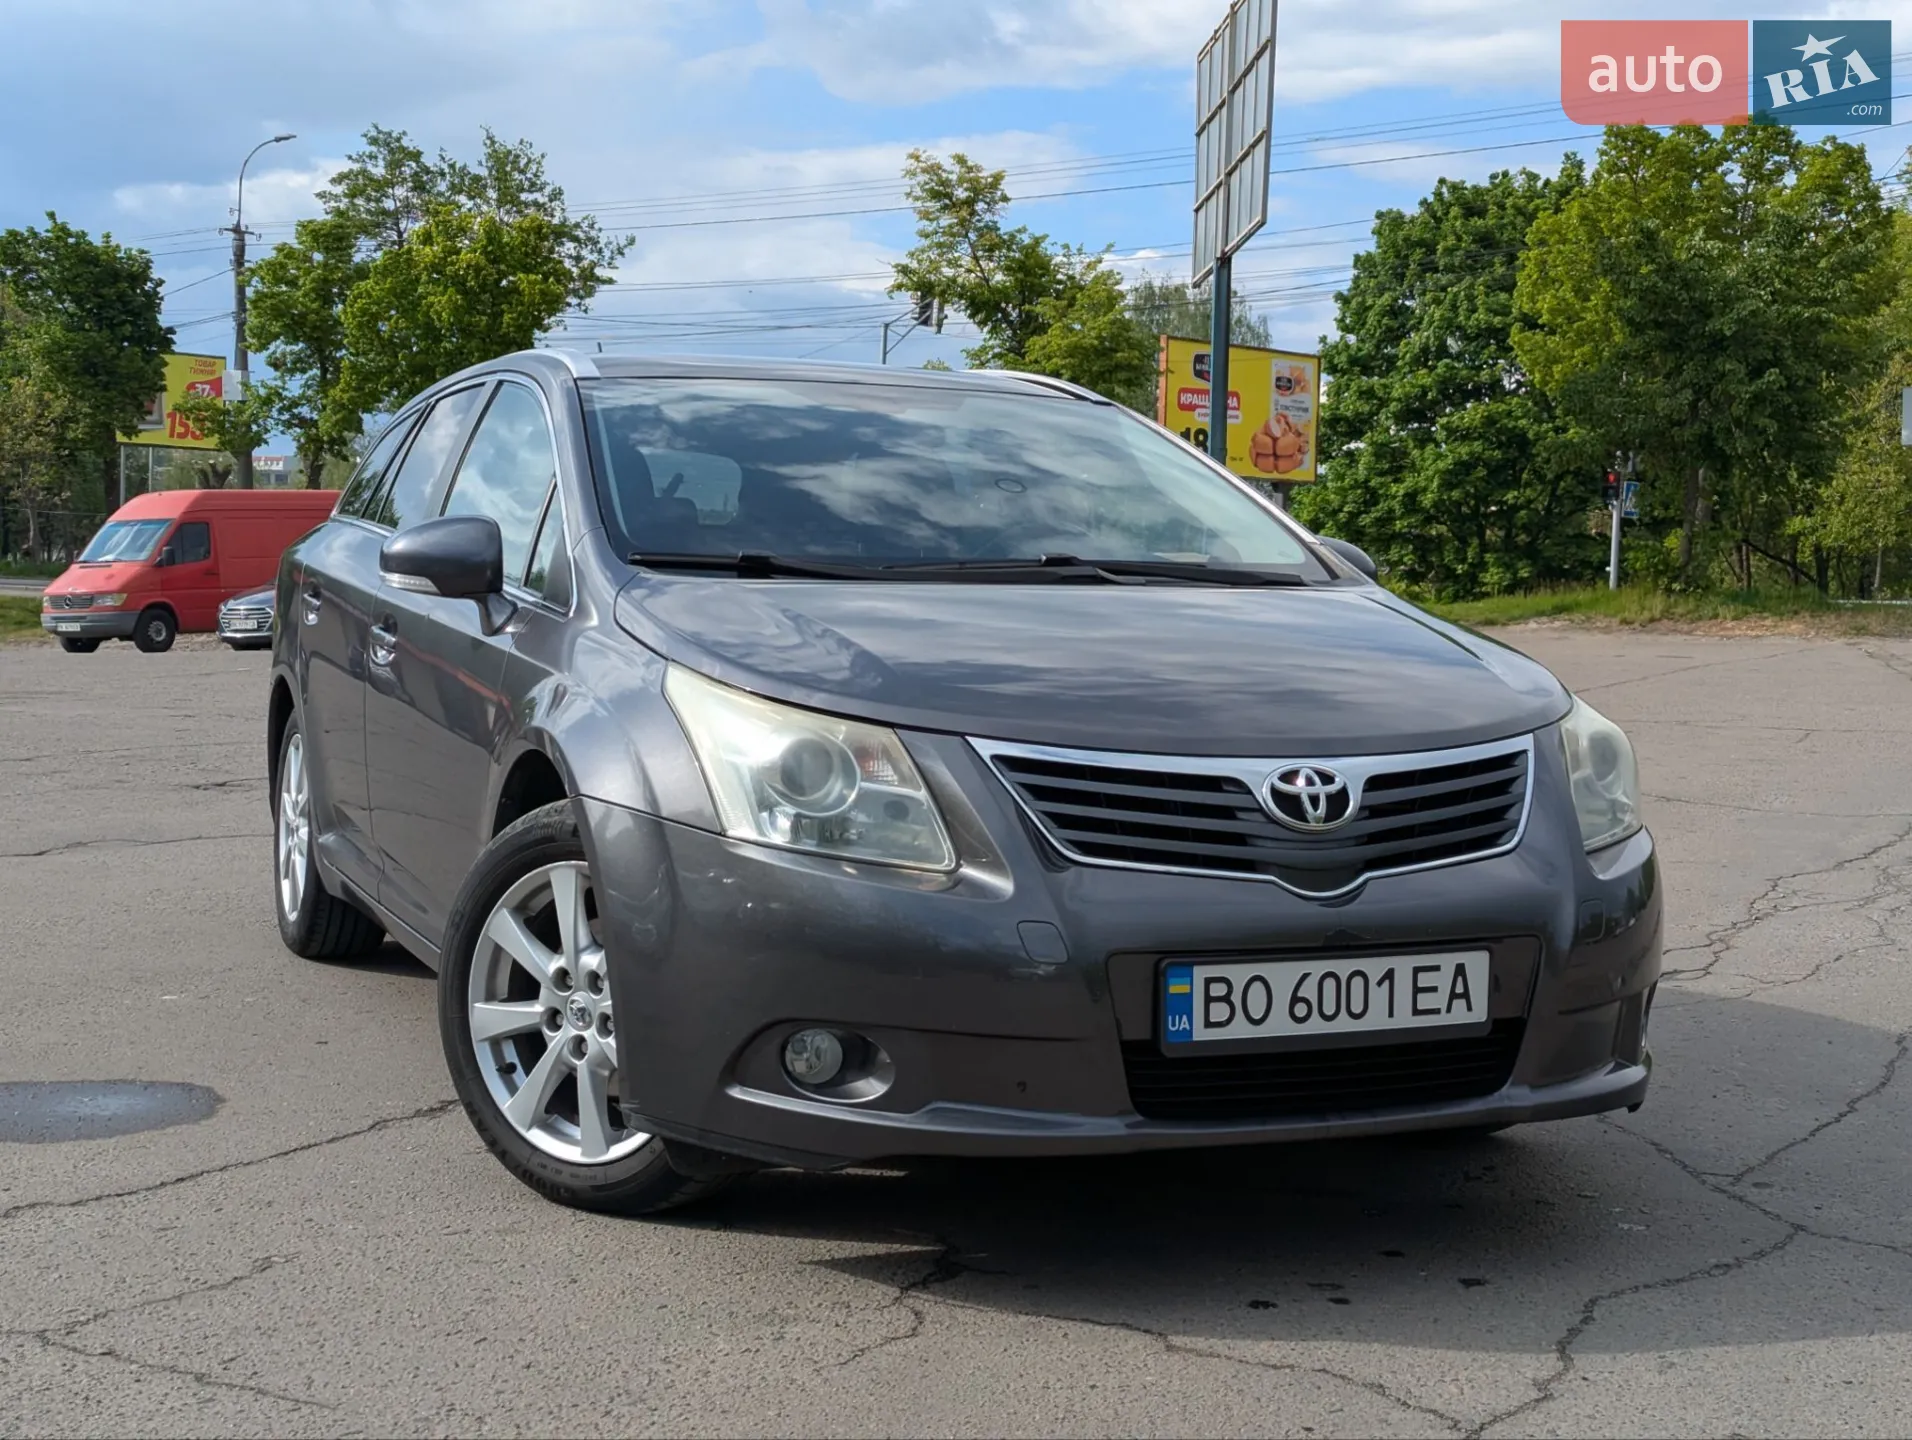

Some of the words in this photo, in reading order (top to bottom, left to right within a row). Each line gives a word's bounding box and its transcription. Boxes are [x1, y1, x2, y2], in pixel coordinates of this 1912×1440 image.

[1180, 392, 1210, 407] КРАЩ
[1203, 974, 1273, 1029] BO
[1288, 967, 1396, 1025] 6001
[1411, 962, 1473, 1017] EA
[1168, 1015, 1190, 1031] UA
